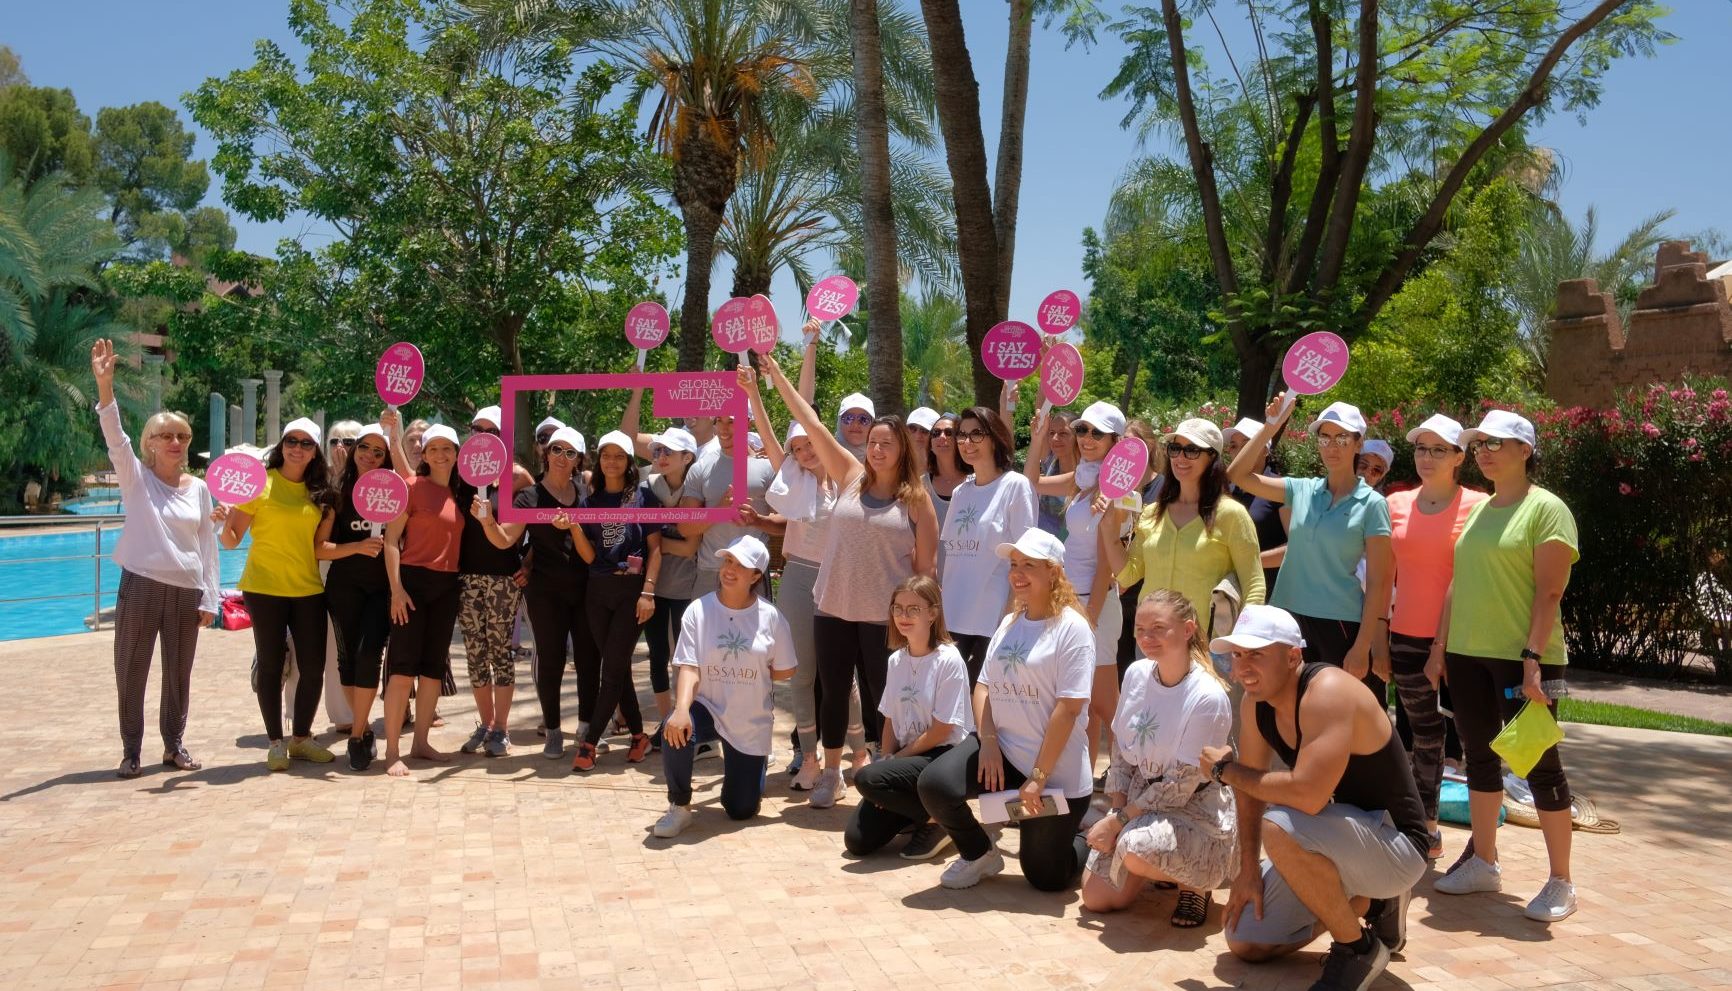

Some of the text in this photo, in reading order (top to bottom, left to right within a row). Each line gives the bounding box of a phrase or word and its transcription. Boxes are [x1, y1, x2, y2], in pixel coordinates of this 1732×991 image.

[814, 287, 846, 301] I SAY
[815, 297, 848, 315] YES!
[1042, 304, 1070, 315] I SAY
[629, 317, 658, 329] I SAY
[746, 315, 768, 331] I SAY
[1045, 312, 1074, 327] YES!
[635, 327, 664, 342] YES!
[717, 322, 723, 334] I
[725, 327, 747, 344] YE
[752, 325, 775, 344] YES!
[988, 341, 1028, 354] I SAY
[997, 353, 1036, 369] YES!
[1292, 345, 1306, 356] I
[1302, 350, 1333, 370] SAY
[381, 362, 412, 378] I SAY
[1047, 355, 1054, 366] I
[1052, 360, 1073, 383] SAY
[1291, 359, 1332, 389] YES!
[386, 376, 417, 395] YES!
[678, 379, 724, 390] GLOBAL
[1046, 369, 1074, 402] YES!
[668, 387, 734, 400] WELLNESS
[699, 399, 726, 411] DAY
[463, 451, 493, 465] I SAY
[1107, 454, 1136, 473] I SAY
[213, 466, 252, 482] I SAY
[470, 460, 501, 477] YES!
[218, 477, 258, 497] YES!
[1105, 467, 1136, 491] YES!
[358, 486, 394, 499] I SAY
[366, 497, 401, 514] YES!
[578, 513, 597, 521] can
[598, 511, 635, 522] change
[637, 513, 658, 522] your
[660, 511, 689, 521] whole
